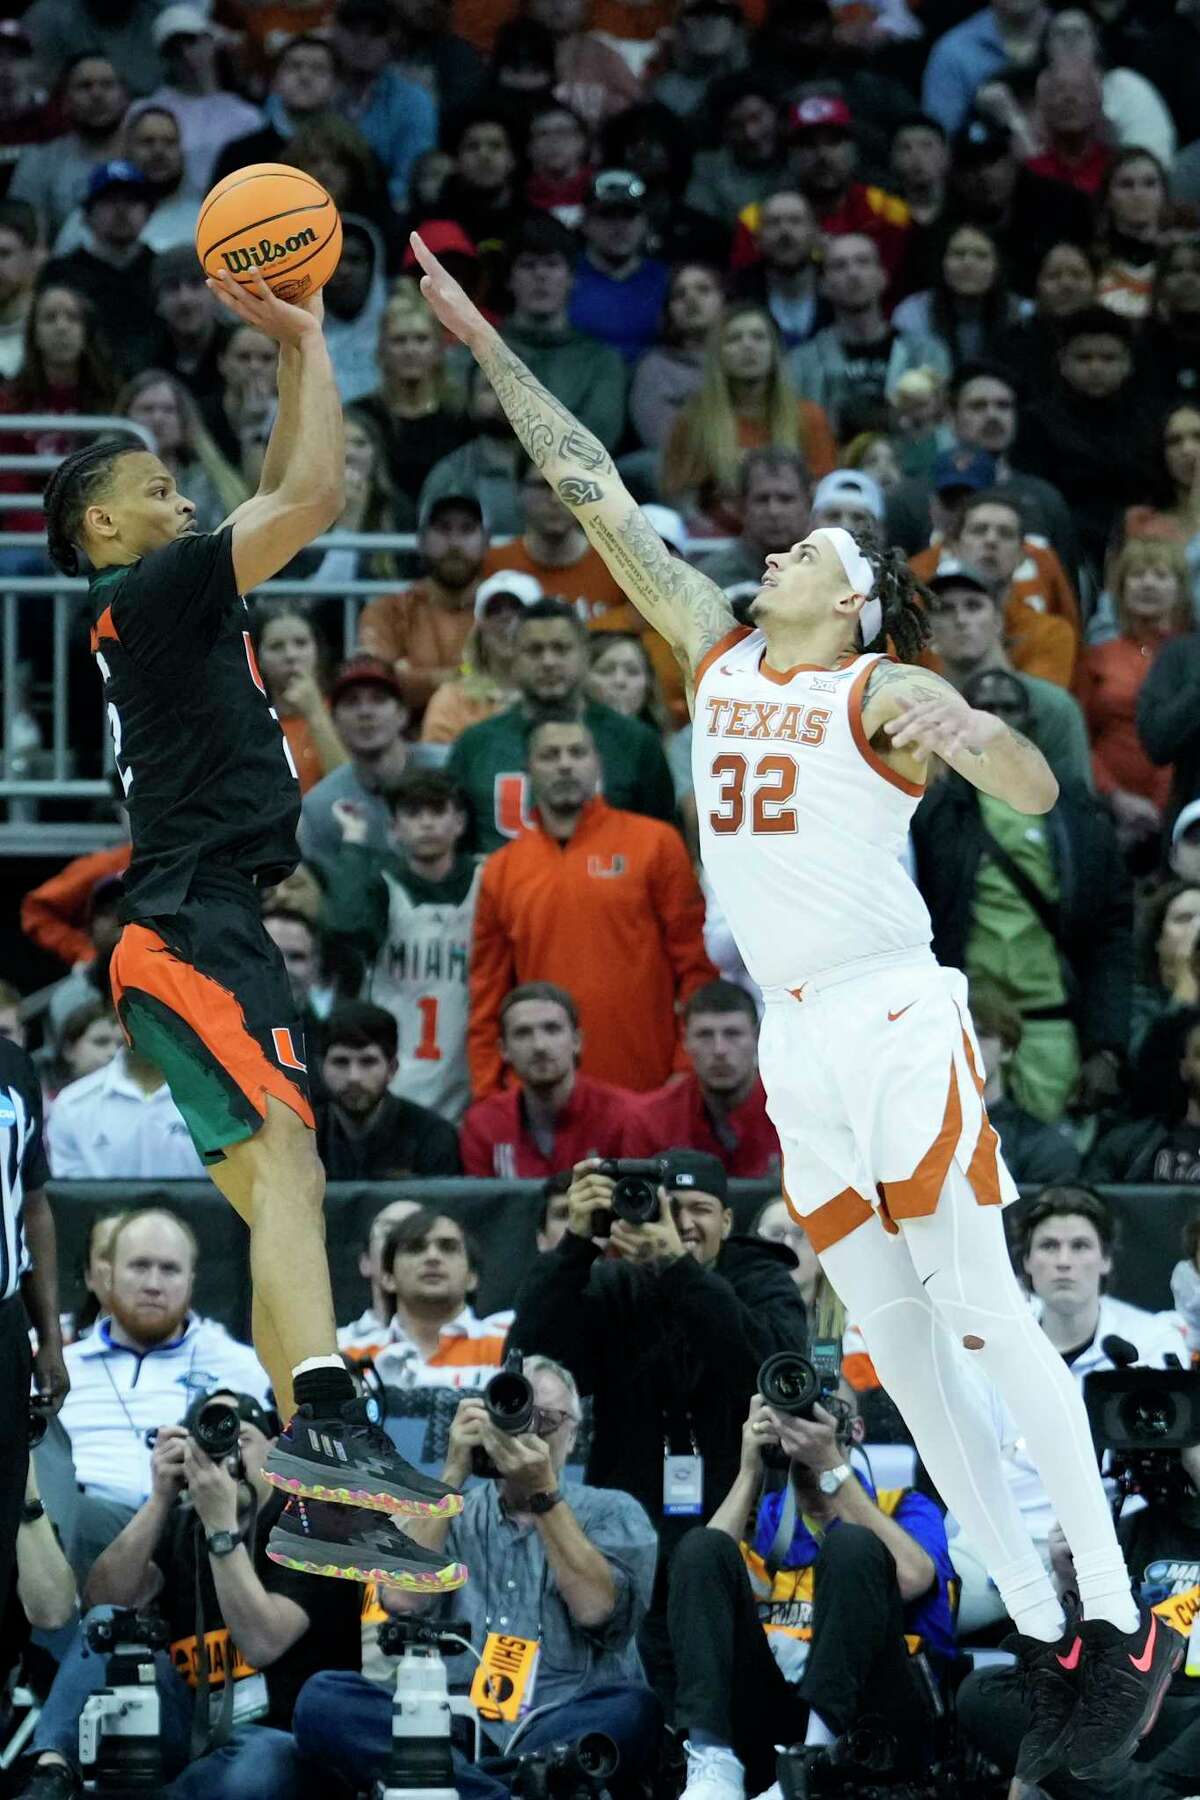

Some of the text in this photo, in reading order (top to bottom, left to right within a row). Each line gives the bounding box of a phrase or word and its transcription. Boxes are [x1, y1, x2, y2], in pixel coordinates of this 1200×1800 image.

[221, 228, 319, 273] Wilson
[705, 696, 832, 748] TEXAS
[709, 752, 799, 836] 32
[389, 938, 467, 983] MIAM
[414, 995, 443, 1061] 1
